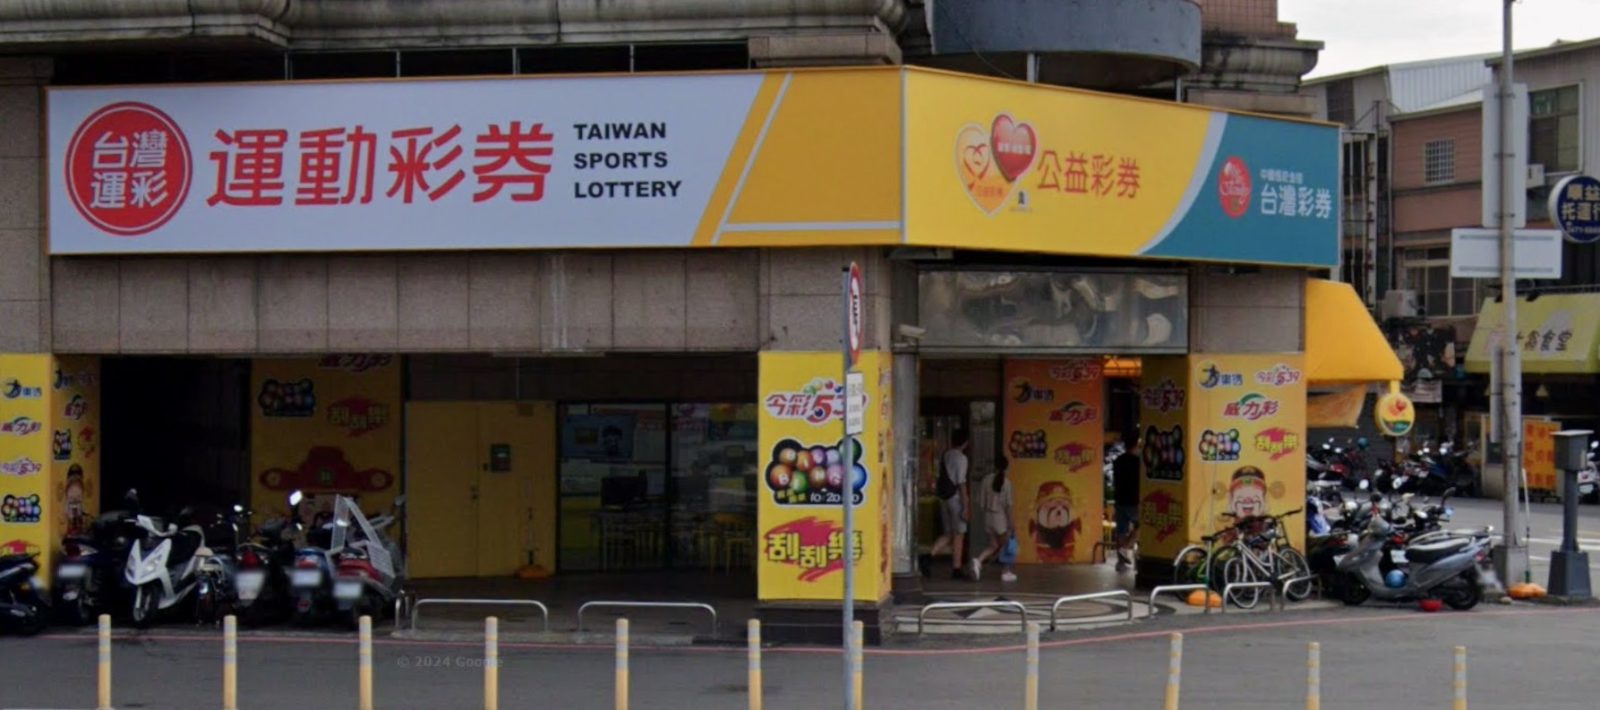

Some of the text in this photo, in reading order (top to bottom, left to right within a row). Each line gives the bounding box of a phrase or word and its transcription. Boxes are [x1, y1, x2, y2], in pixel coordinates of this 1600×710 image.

[91, 128, 168, 169] 台灣
[573, 122, 667, 140] TAIWAN
[206, 120, 555, 206] 運動彩券
[573, 152, 669, 170] SPORTS
[1037, 150, 1141, 199] 公益彩券
[90, 171, 168, 209] 運彩
[573, 180, 682, 198] LOTTERY
[1260, 183, 1332, 219] 台灣彩券
[766, 394, 867, 423] 今彩53
[767, 530, 863, 569] 刮刮樂
